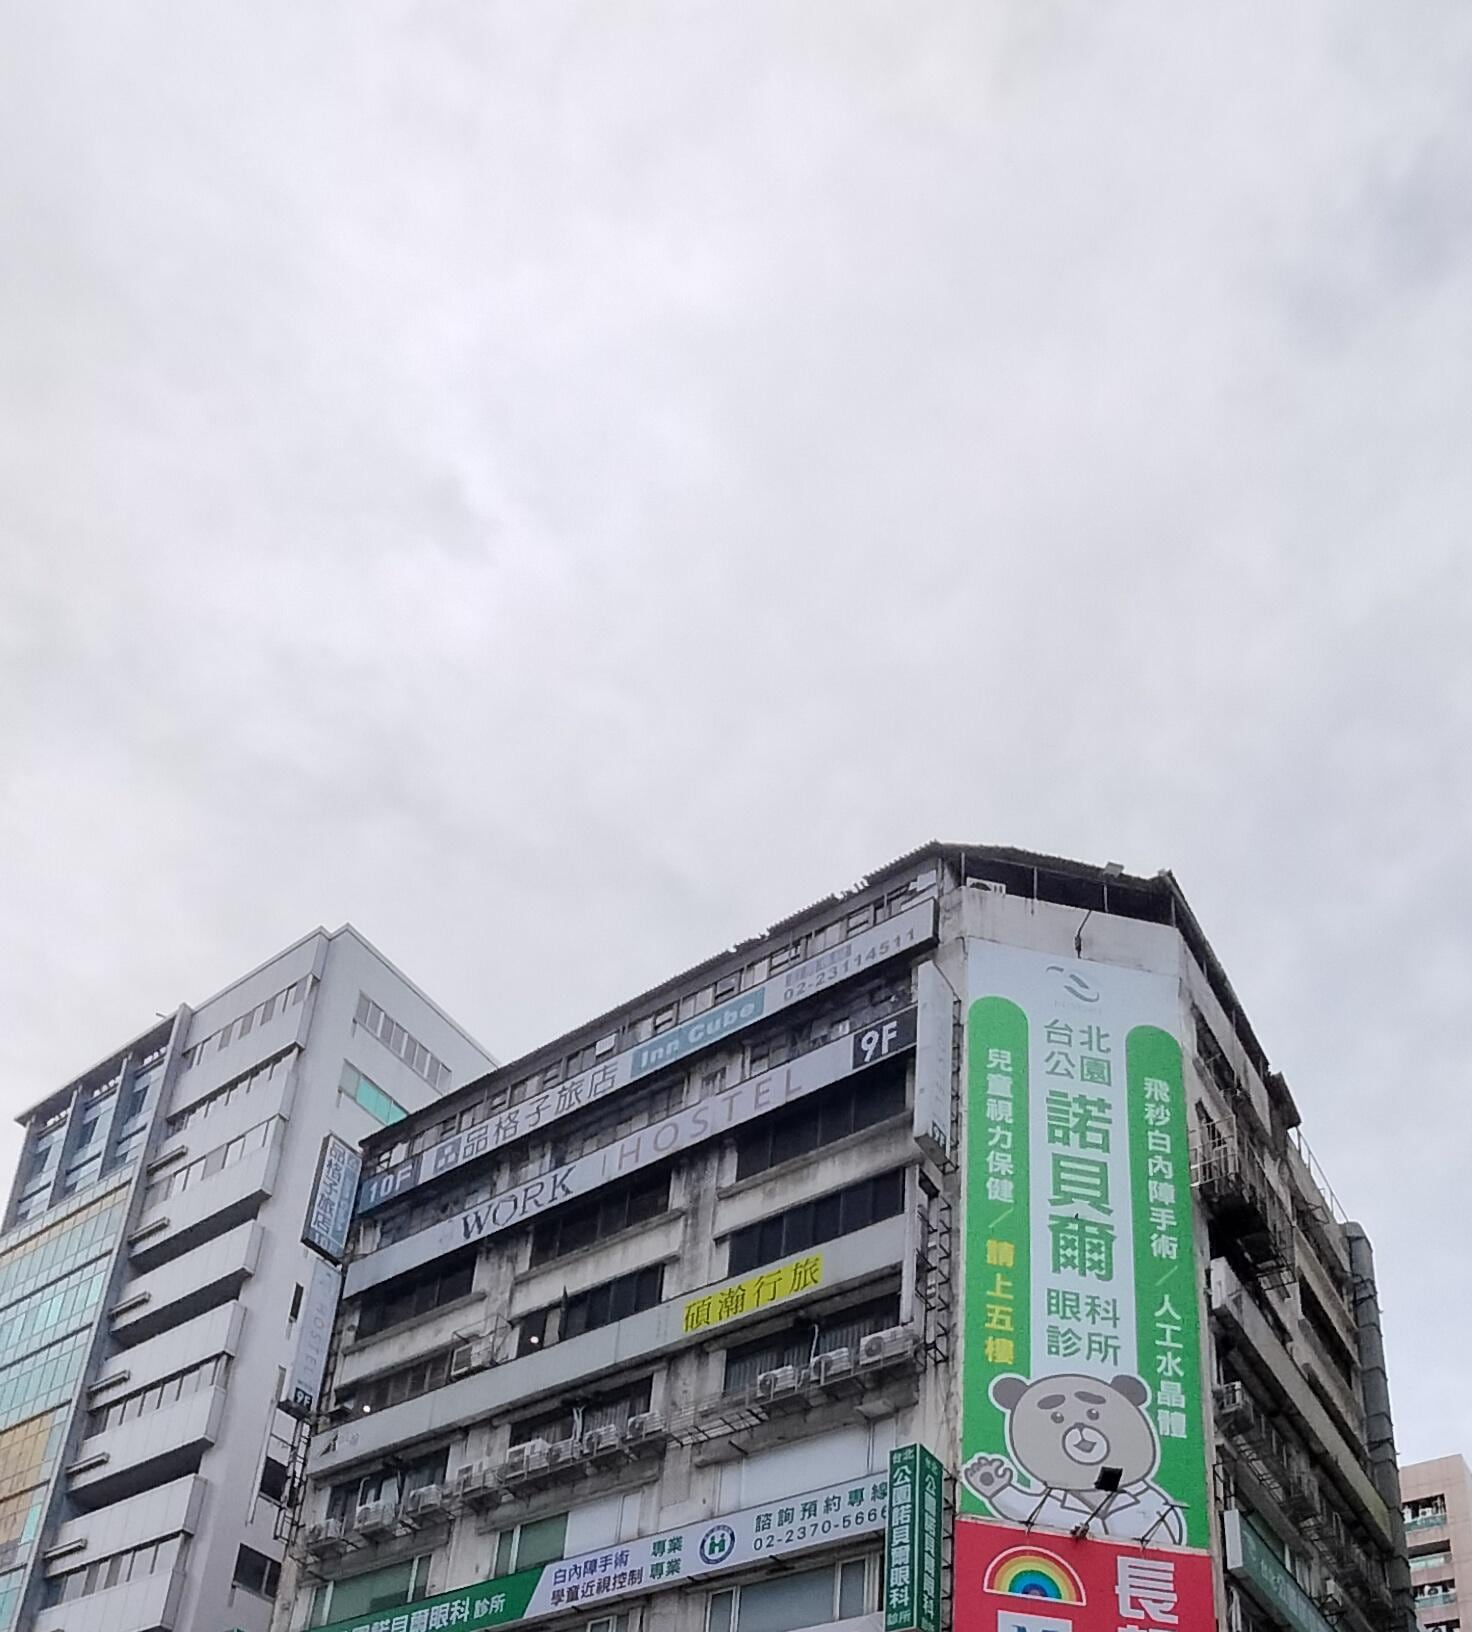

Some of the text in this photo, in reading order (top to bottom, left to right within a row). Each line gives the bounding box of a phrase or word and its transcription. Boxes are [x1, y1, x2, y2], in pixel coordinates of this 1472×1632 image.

[784, 927, 915, 1001] 02-23114511
[638, 1002, 757, 1071] Inn Cube
[860, 1020, 898, 1063] 9F
[1044, 1019, 1112, 1053] 台北
[1044, 1051, 1113, 1087] 公園
[462, 1064, 617, 1172] 品格子旅店
[368, 1163, 414, 1203] 10F
[461, 1070, 802, 1241] WORK HOSTEL
[1045, 1090, 1114, 1283] 諾貝爾
[984, 1048, 1016, 1367] 兒童視力保健 請上五樓
[1142, 1077, 1188, 1440] 飛秒白內障手術 人工水晶體
[684, 1257, 822, 1333] 碩瀚行旅
[1047, 1287, 1121, 1330] 眼科
[1047, 1325, 1122, 1368] 診所
[552, 1550, 631, 1586] 白內障手術
